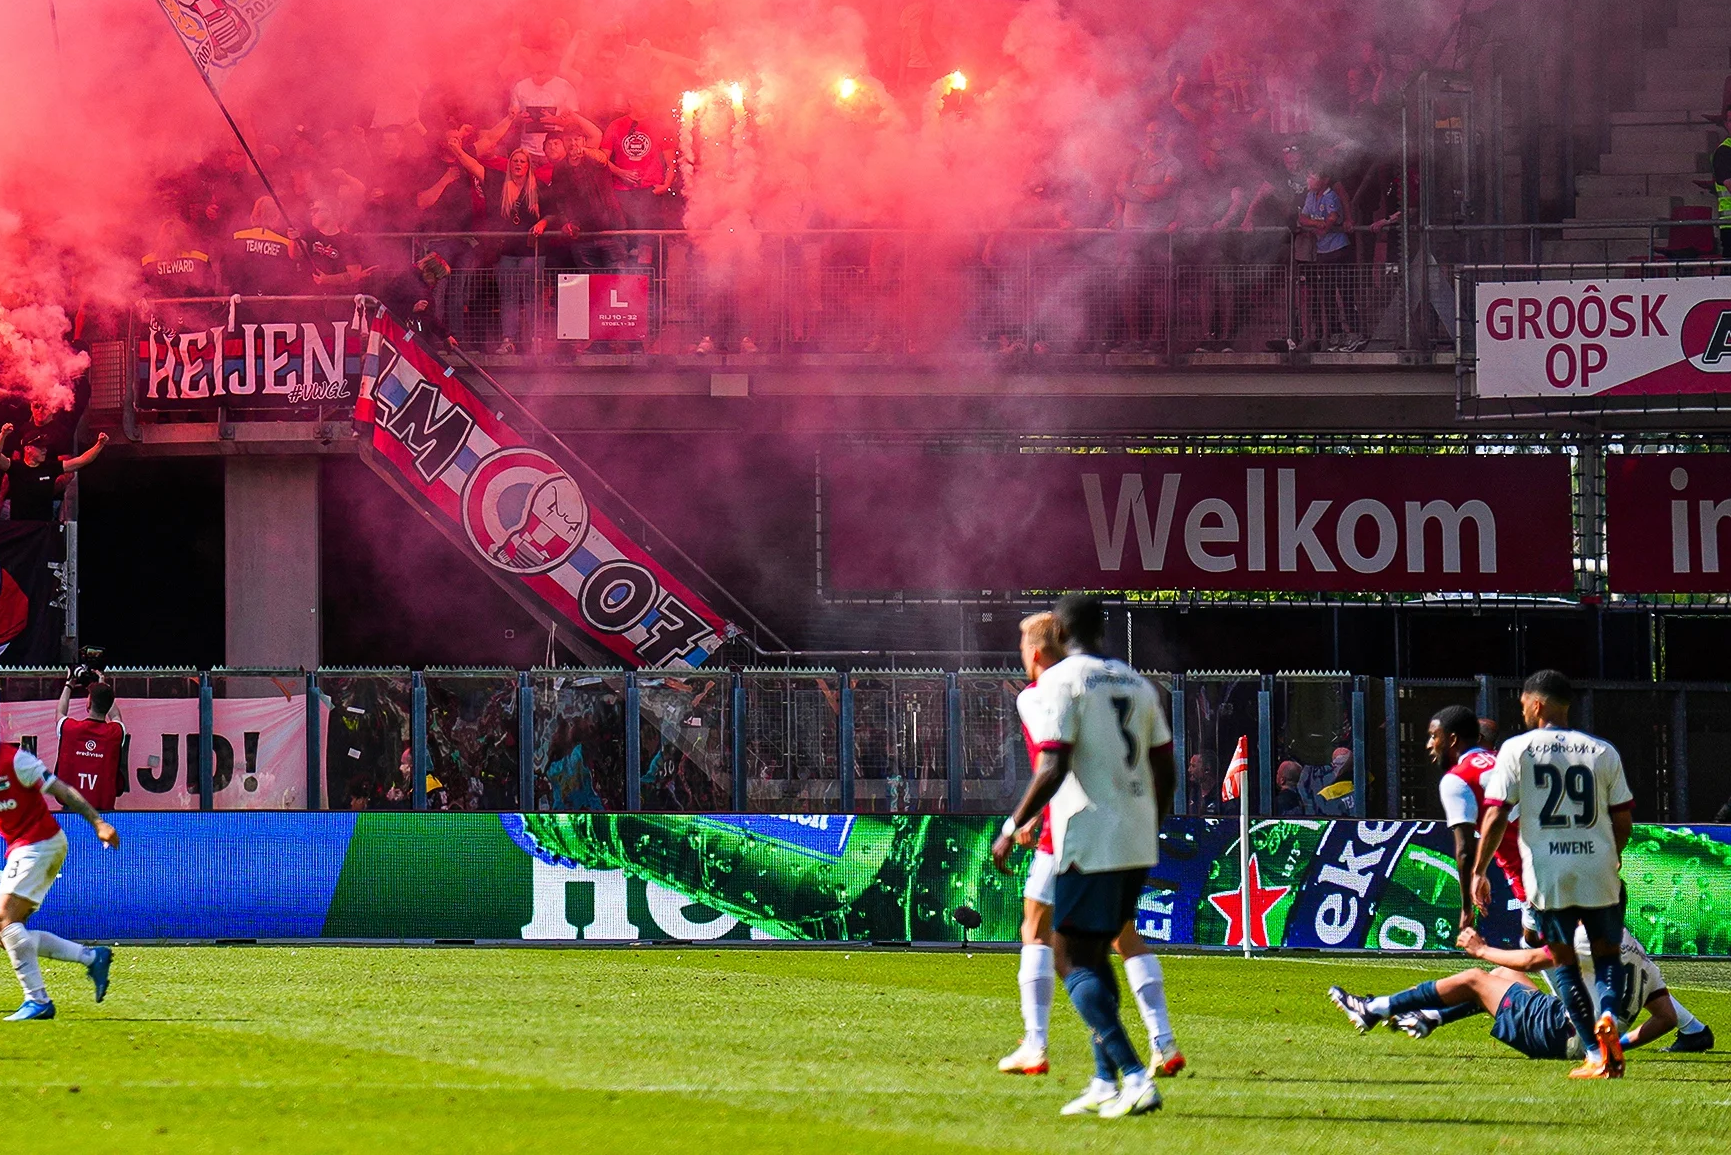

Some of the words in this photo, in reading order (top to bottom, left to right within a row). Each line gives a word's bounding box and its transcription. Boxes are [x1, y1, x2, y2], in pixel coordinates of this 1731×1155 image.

[246, 239, 263, 254] TEAM
[157, 260, 195, 275] STEWARD
[611, 289, 628, 307] L
[1485, 285, 1670, 341] GROÔSK
[147, 321, 349, 399] HEIJEN
[1545, 343, 1608, 389] OP
[288, 379, 351, 403] #VWGL
[1081, 467, 1497, 574] Welkom
[1111, 695, 1140, 771] 3
[78, 773, 98, 790] TV
[1533, 764, 1598, 829] 29
[1549, 840, 1596, 855] MWENE
[1282, 849, 1302, 877] 1873
